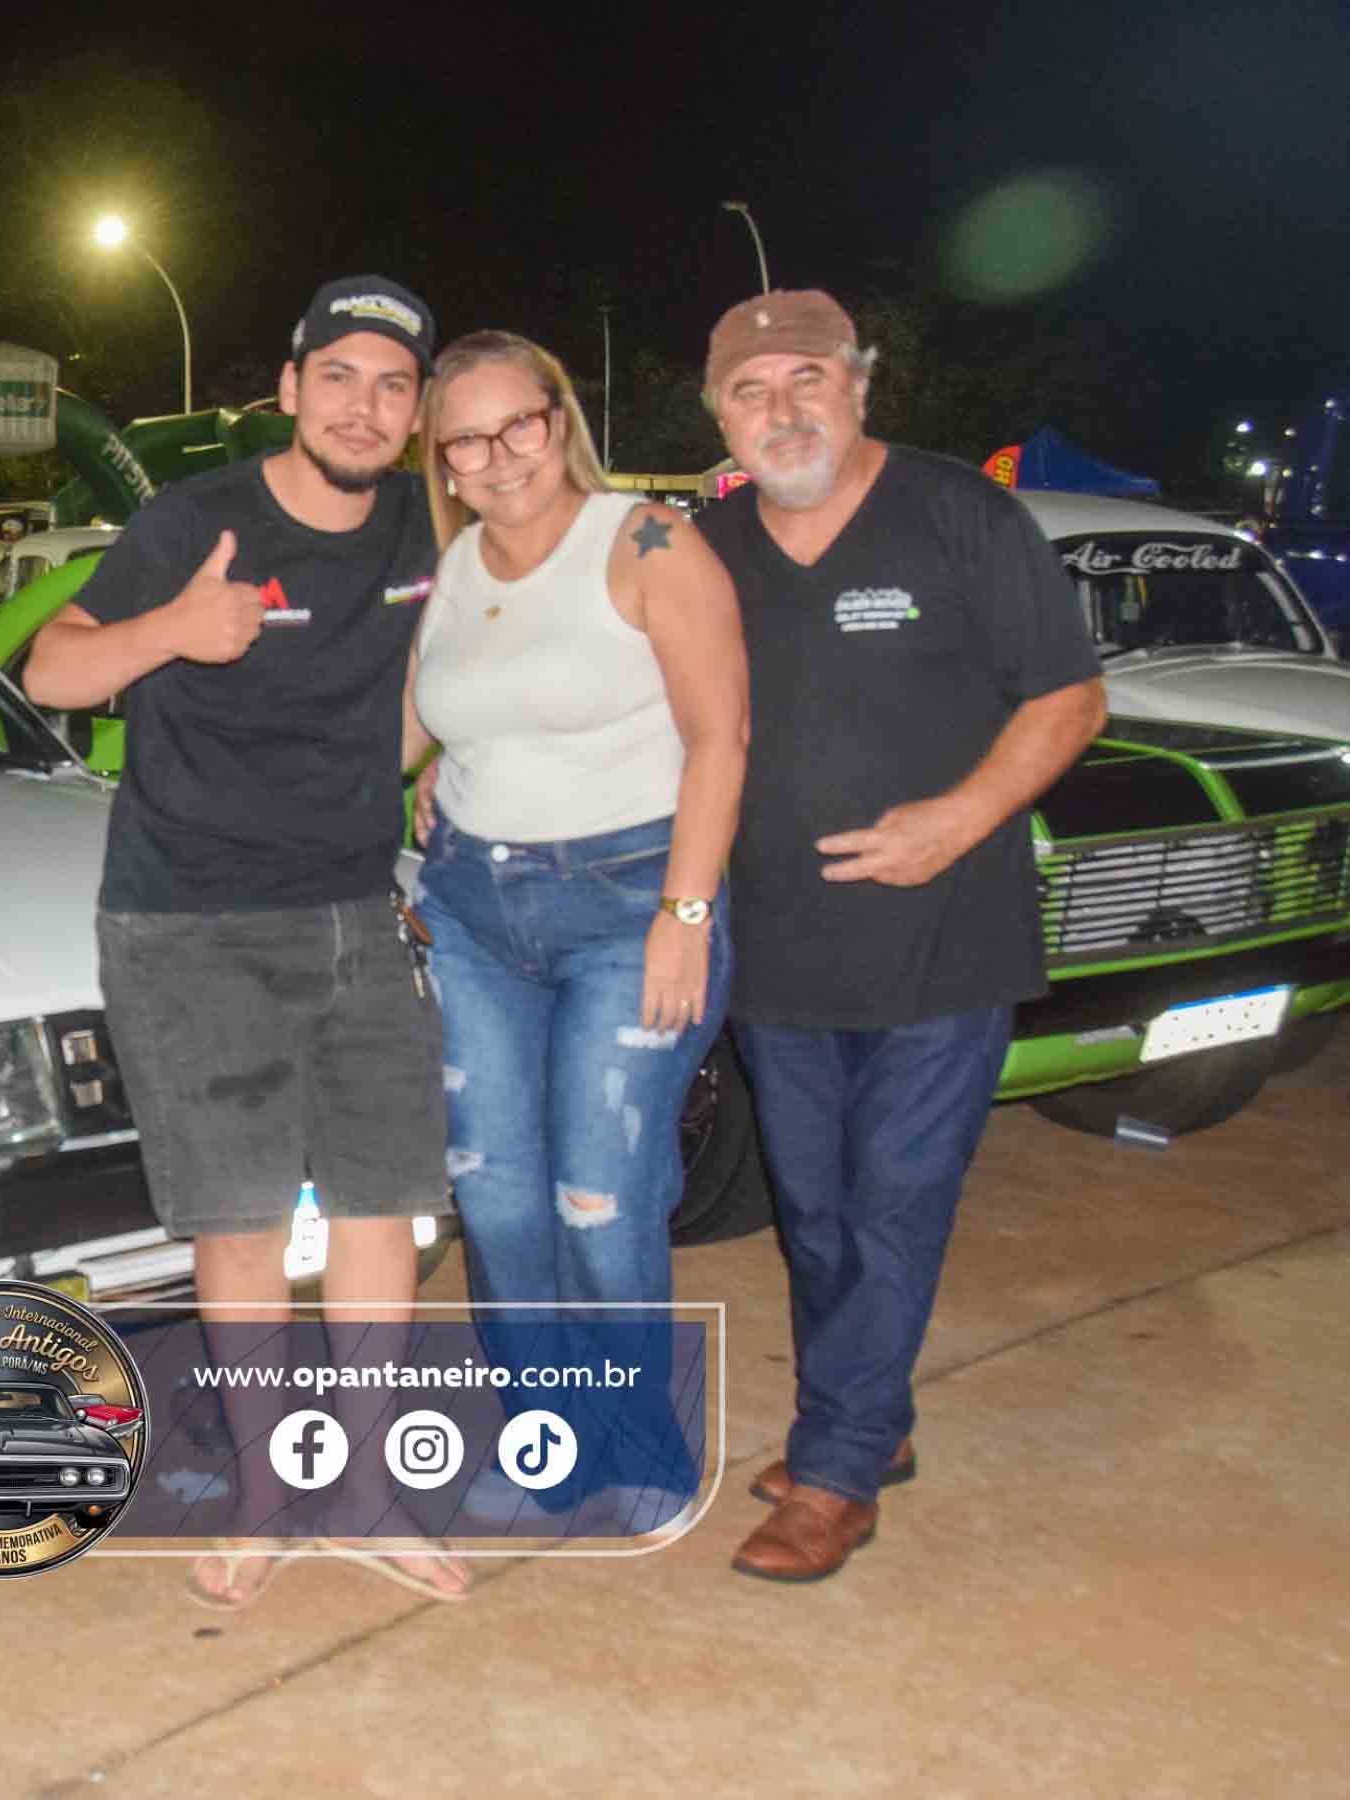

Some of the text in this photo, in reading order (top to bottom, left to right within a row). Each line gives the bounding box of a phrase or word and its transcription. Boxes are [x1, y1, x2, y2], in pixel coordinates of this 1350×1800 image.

[100, 433, 156, 510] PIT STO
[1062, 541, 1242, 576] Air Cooled
